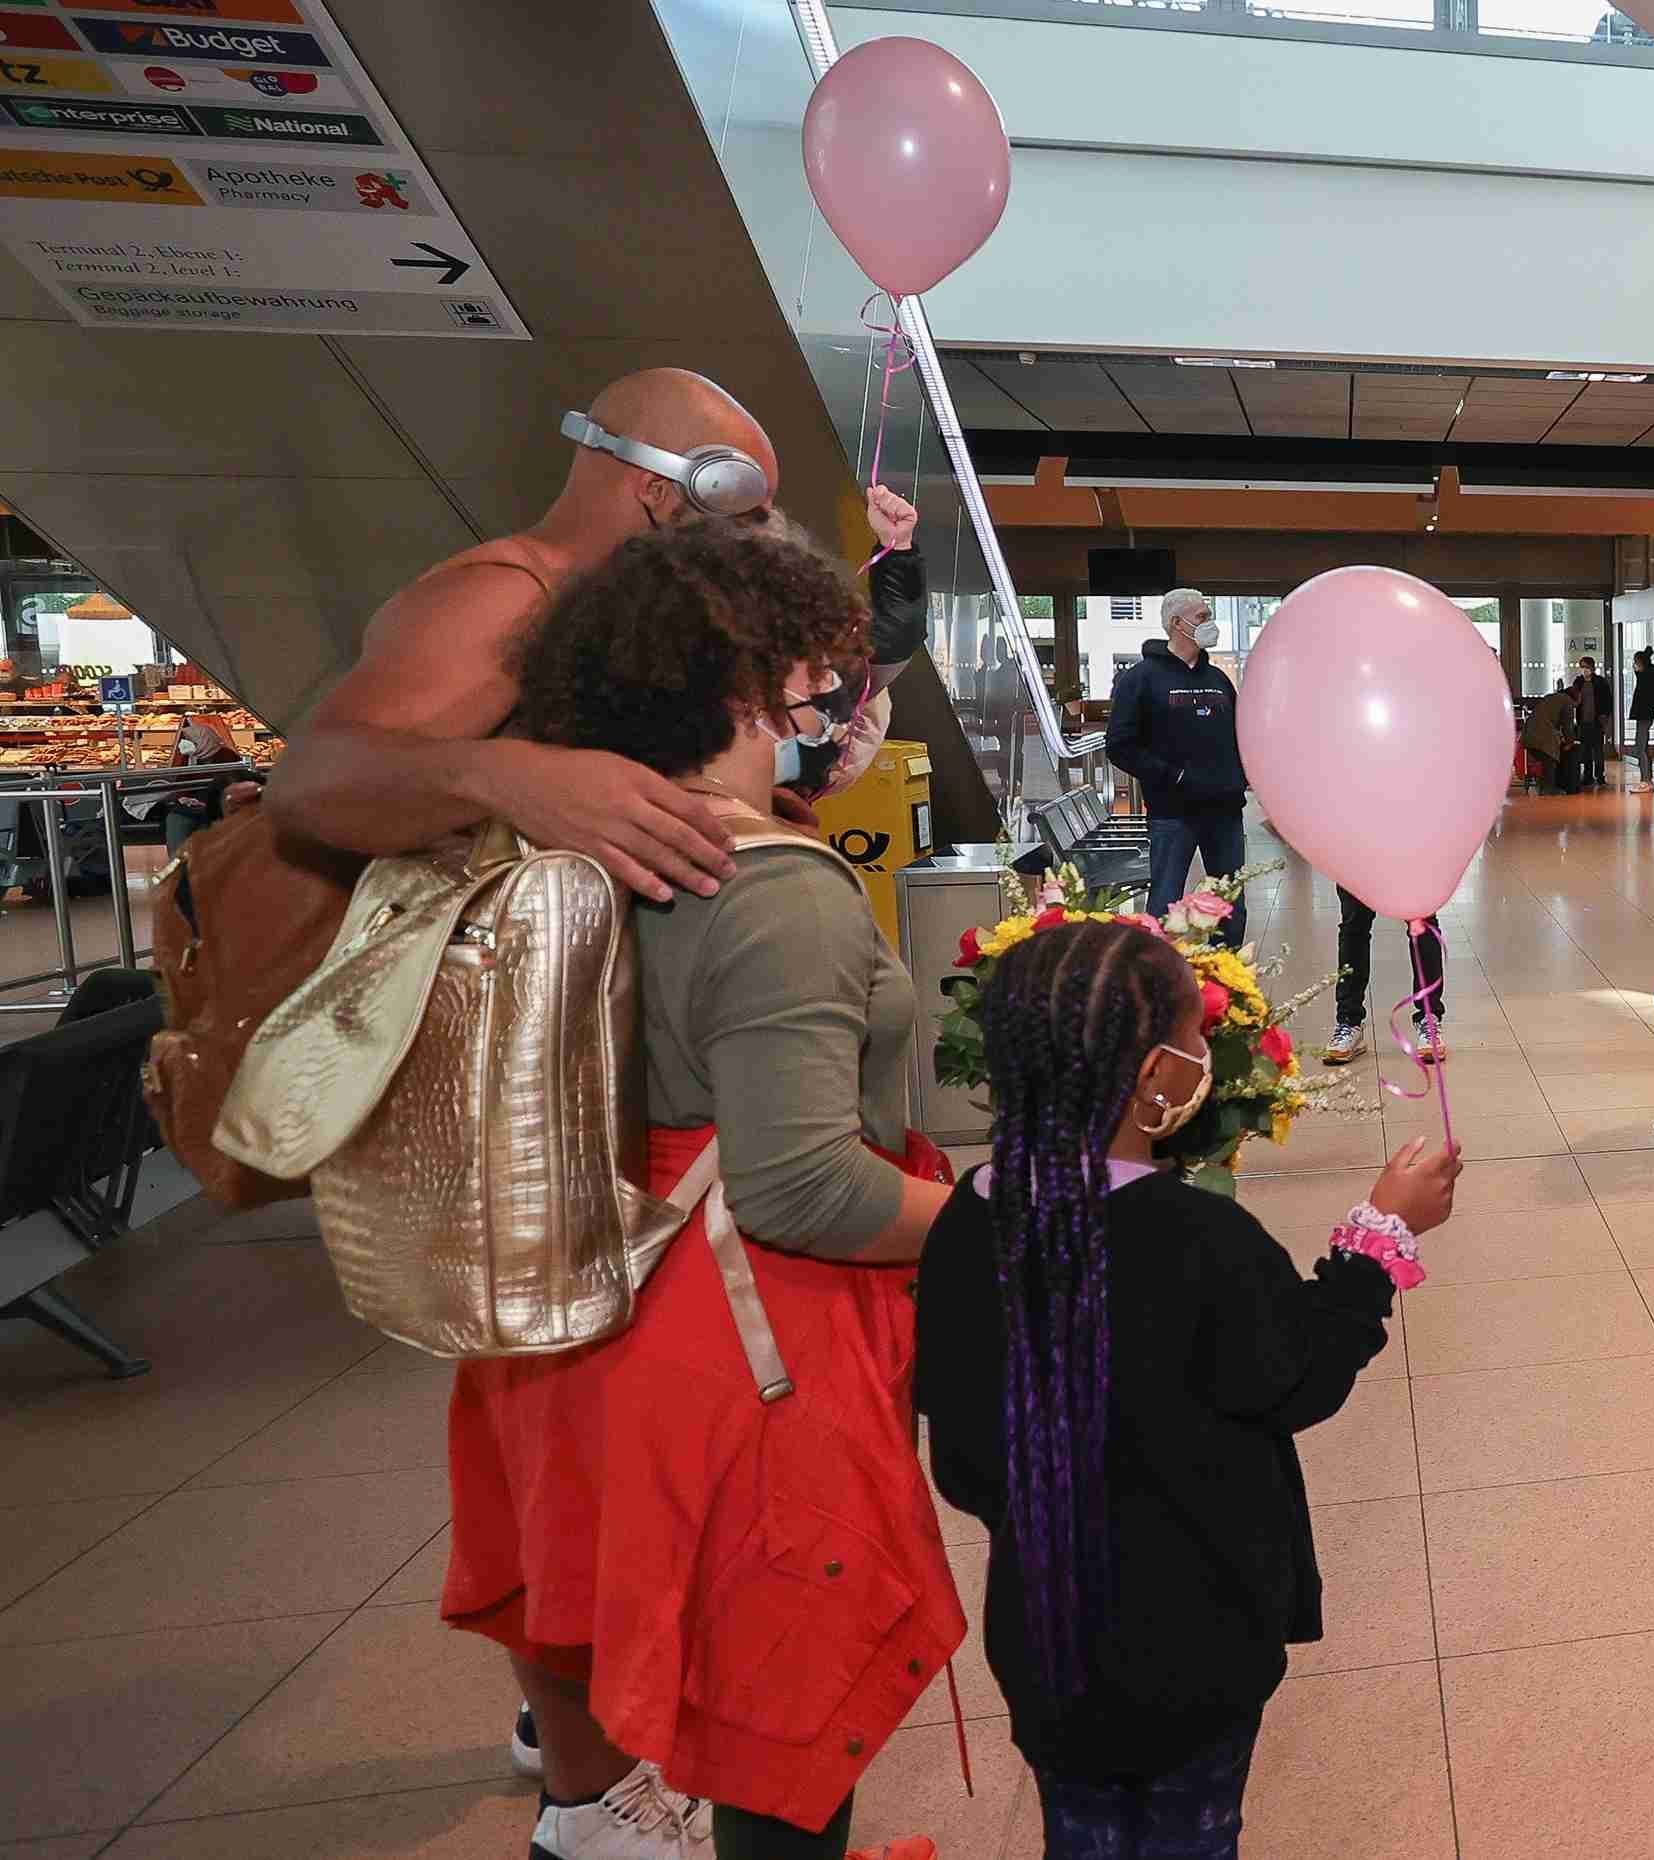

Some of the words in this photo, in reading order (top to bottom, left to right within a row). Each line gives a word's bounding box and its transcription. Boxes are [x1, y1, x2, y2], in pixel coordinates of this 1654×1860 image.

[161, 26, 287, 58] Budget
[254, 117, 349, 137] National
[208, 167, 337, 188] Apotheke
[218, 187, 311, 203] Pharmacy
[34, 241, 128, 257] Terminal
[50, 259, 142, 273] Terminal
[170, 262, 216, 277] level
[175, 307, 241, 321] storage
